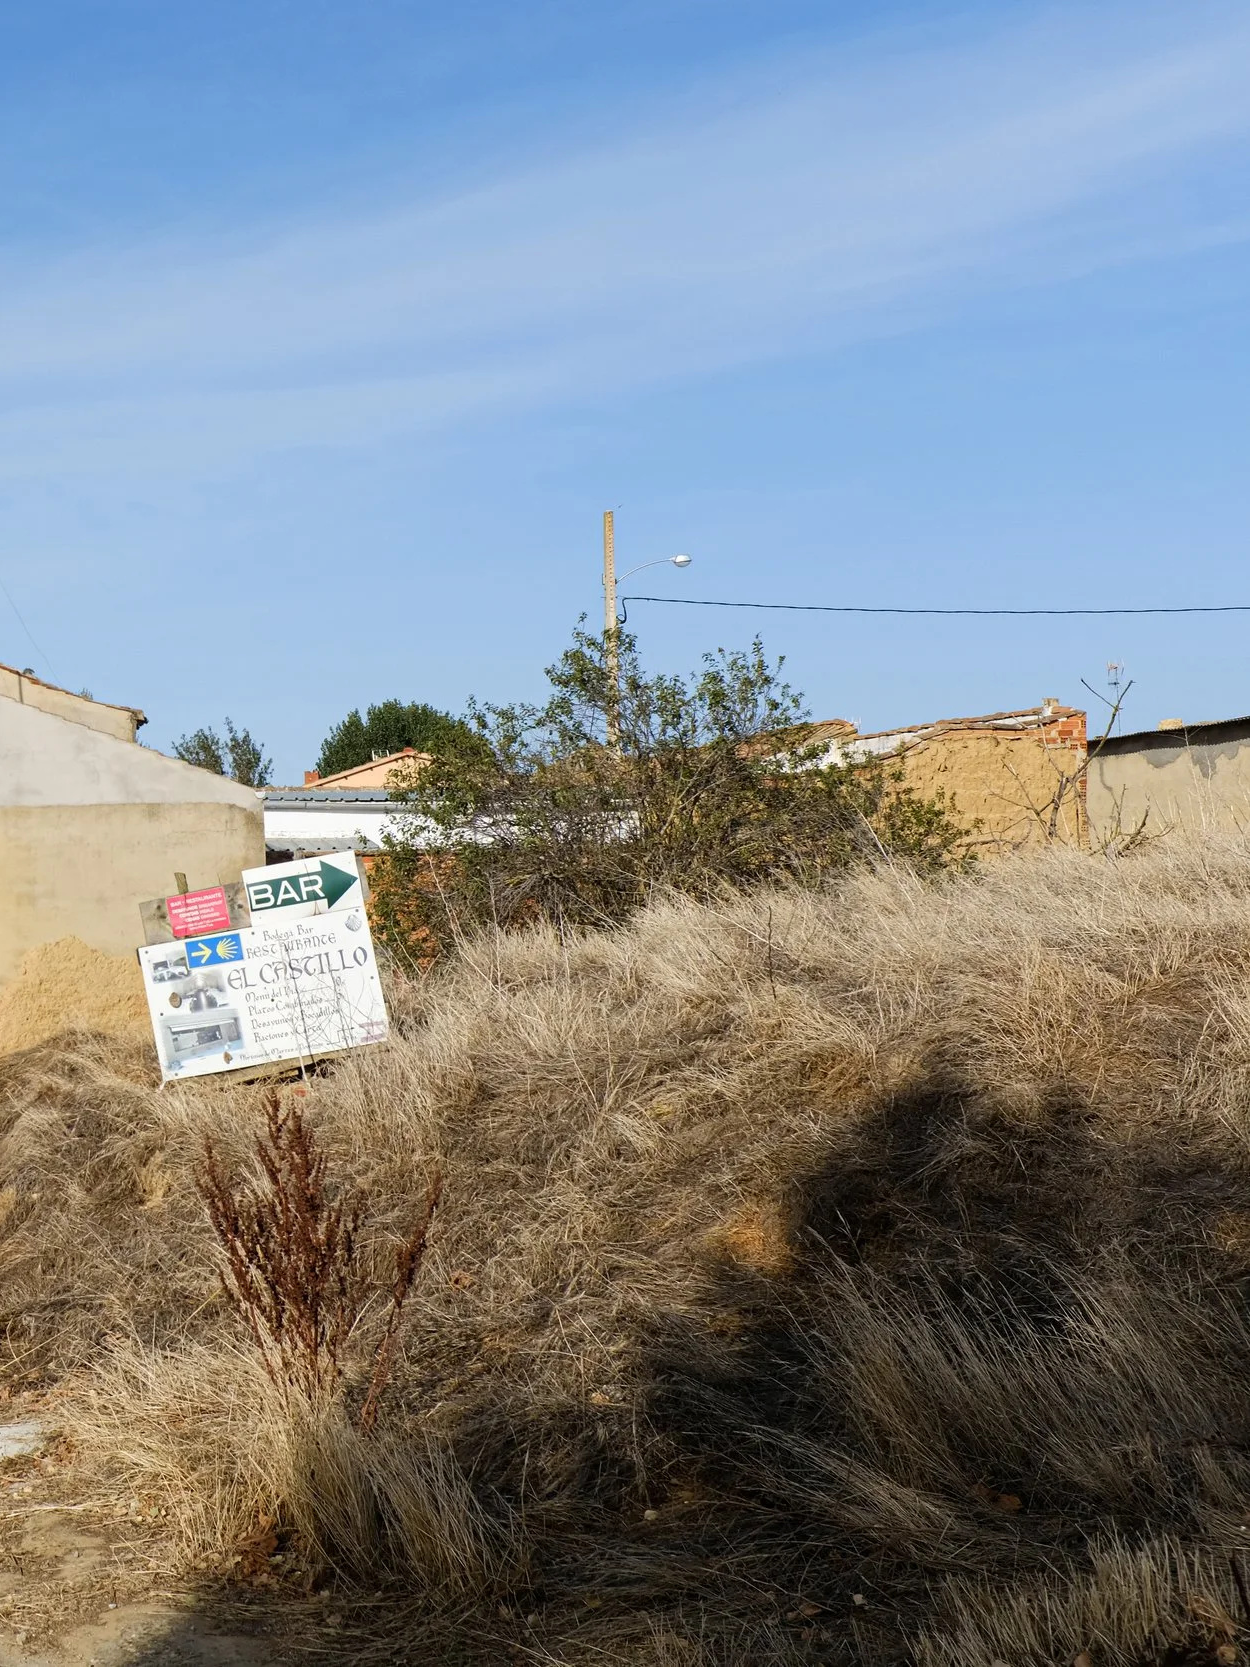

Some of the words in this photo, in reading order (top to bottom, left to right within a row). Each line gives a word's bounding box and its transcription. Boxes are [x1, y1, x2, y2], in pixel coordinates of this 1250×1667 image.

[249, 874, 326, 910] BAR
[263, 929, 293, 942] Bodega
[297, 924, 314, 936] Bar
[227, 967, 257, 990] EL
[259, 946, 368, 985] CASTILLO
